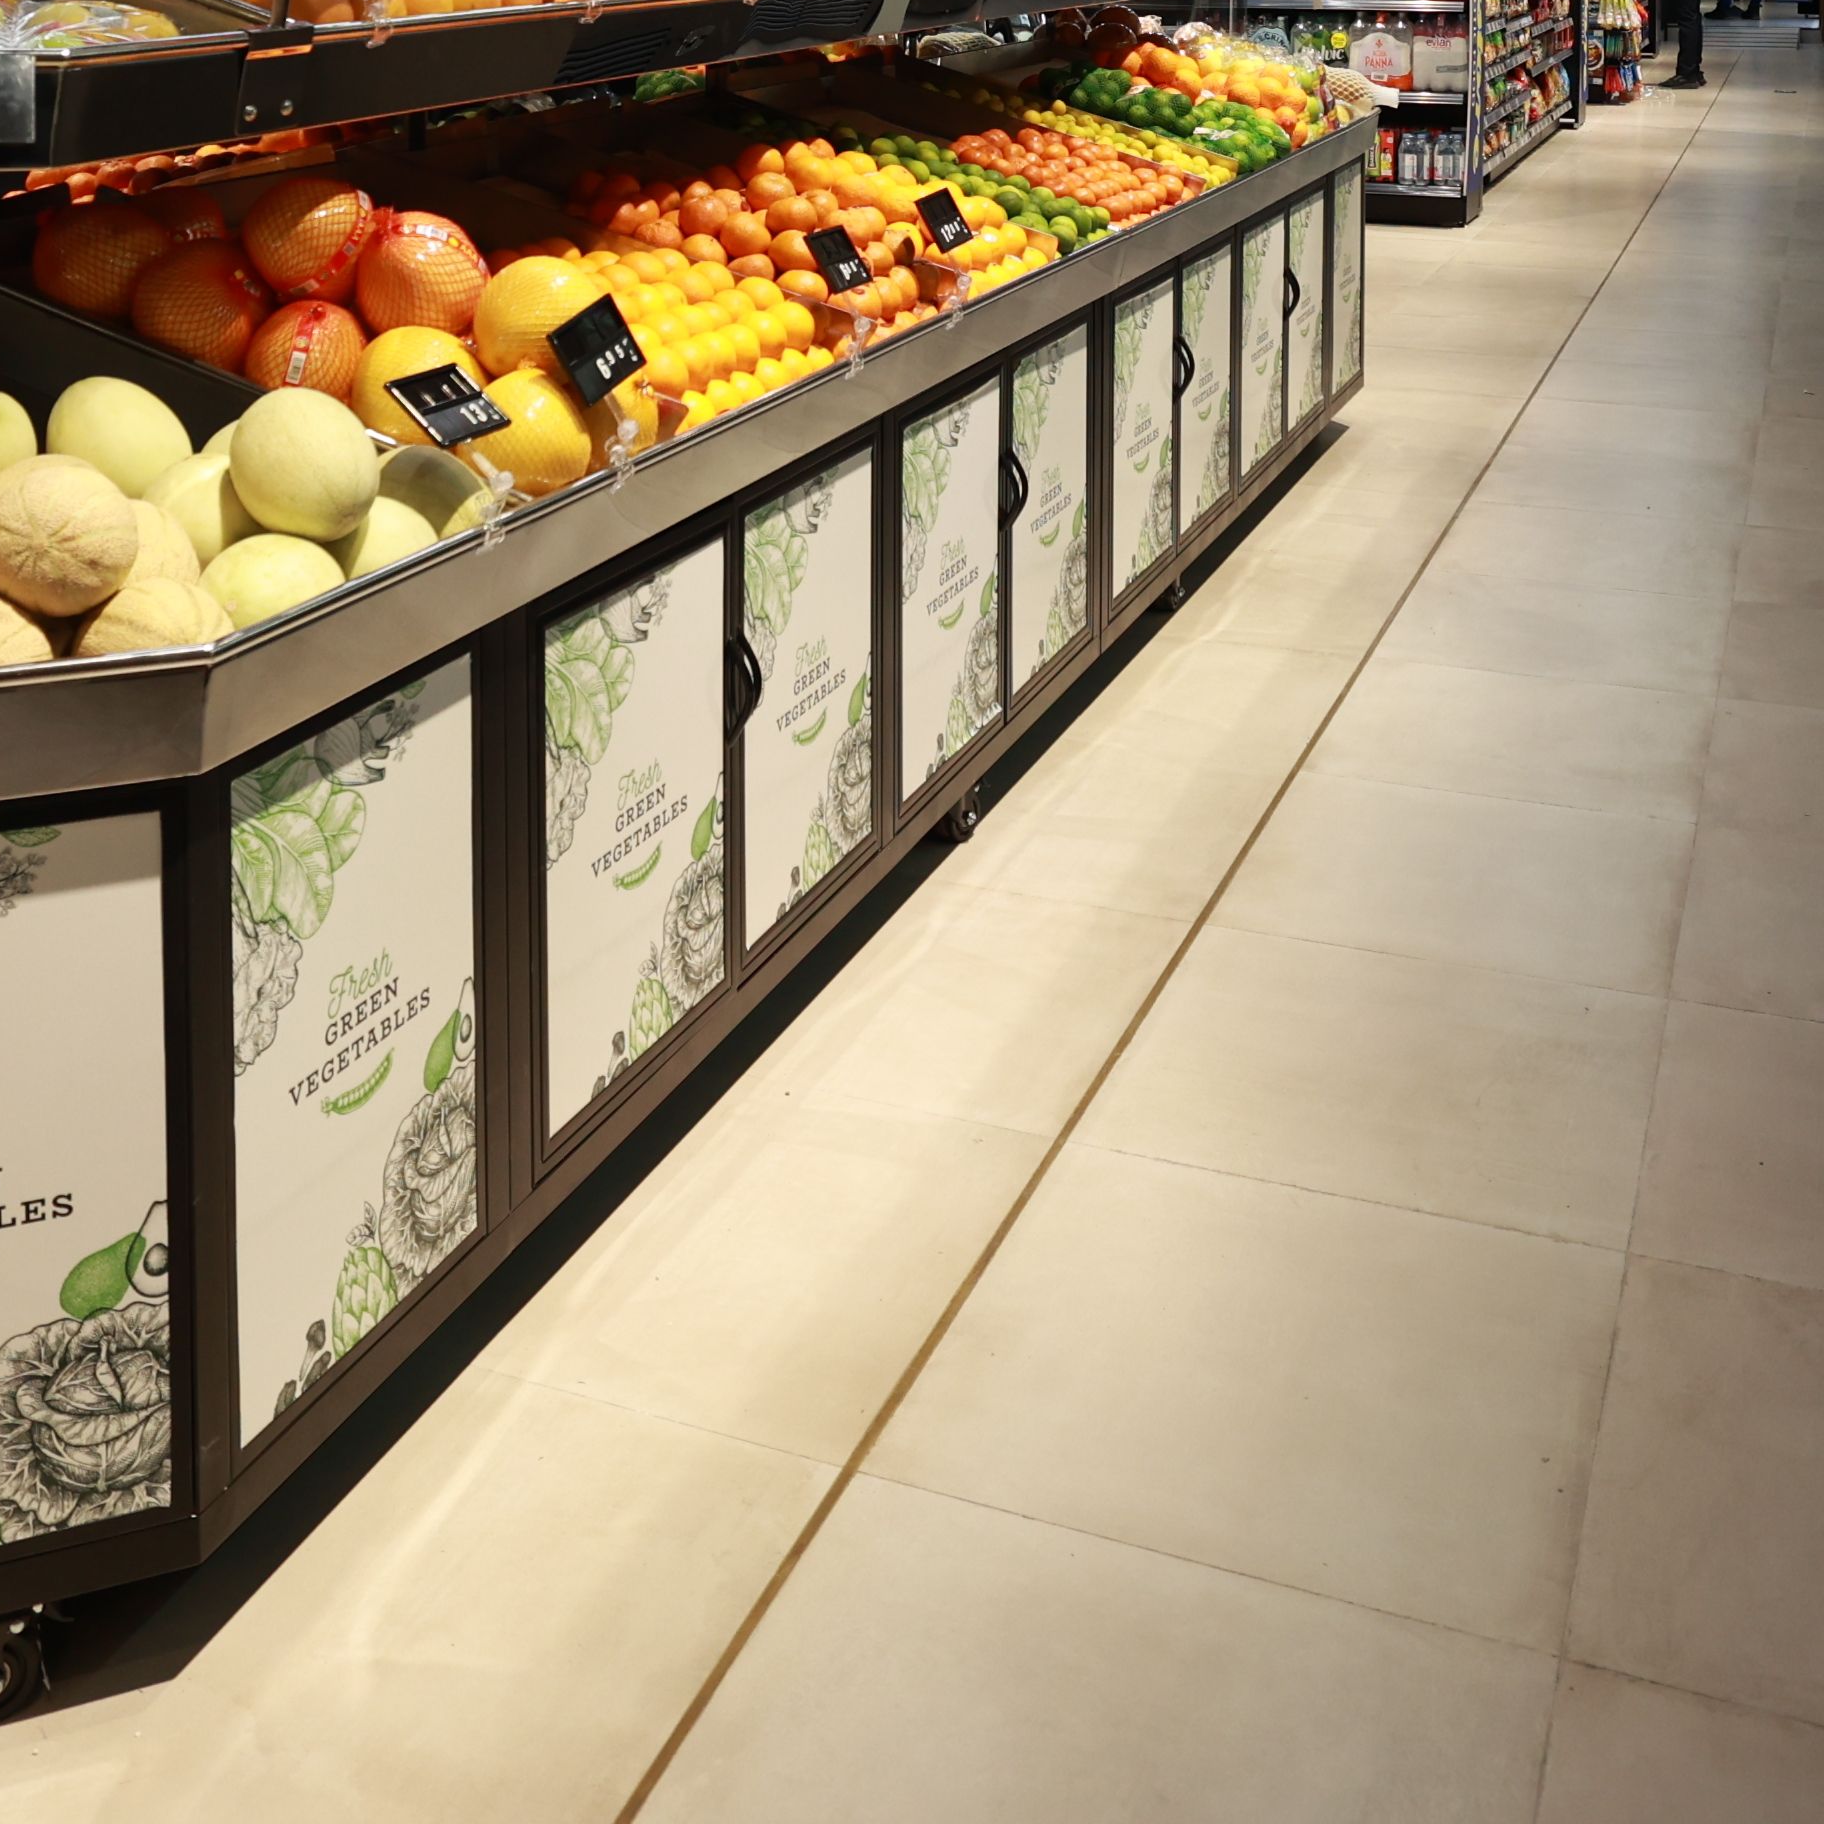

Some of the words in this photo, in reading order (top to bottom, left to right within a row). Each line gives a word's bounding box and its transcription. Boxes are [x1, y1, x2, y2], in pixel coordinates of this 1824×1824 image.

[1364, 55, 1393, 68] PANNA
[926, 566, 980, 617] VEGETABLES
[938, 554, 968, 587] GREEN
[793, 657, 831, 697] GREEN
[794, 634, 828, 677] Fresh
[776, 668, 848, 733] VEGETABLES
[614, 783, 667, 834] GREEN
[617, 757, 664, 812] Fresh
[590, 794, 689, 879] VEGETABLES
[327, 945, 393, 1020] Fresh
[325, 976, 400, 1047] GREEN
[288, 986, 431, 1107] VEGETABLES
